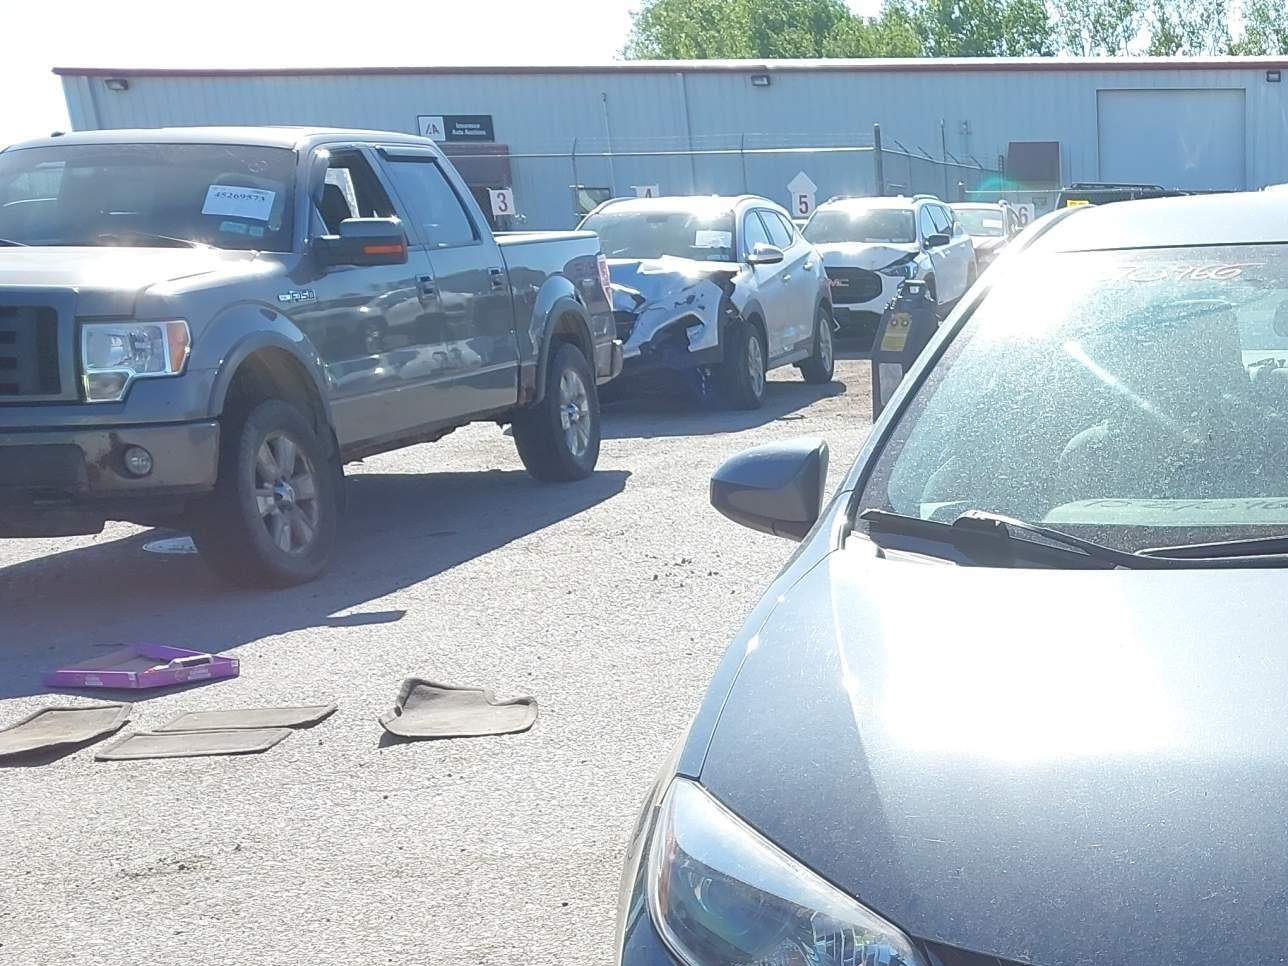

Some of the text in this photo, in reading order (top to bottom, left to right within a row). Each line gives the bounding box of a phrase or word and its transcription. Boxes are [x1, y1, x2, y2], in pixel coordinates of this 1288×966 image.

[496, 192, 508, 213] 3
[799, 194, 809, 214] 5
[1018, 206, 1029, 225] 6
